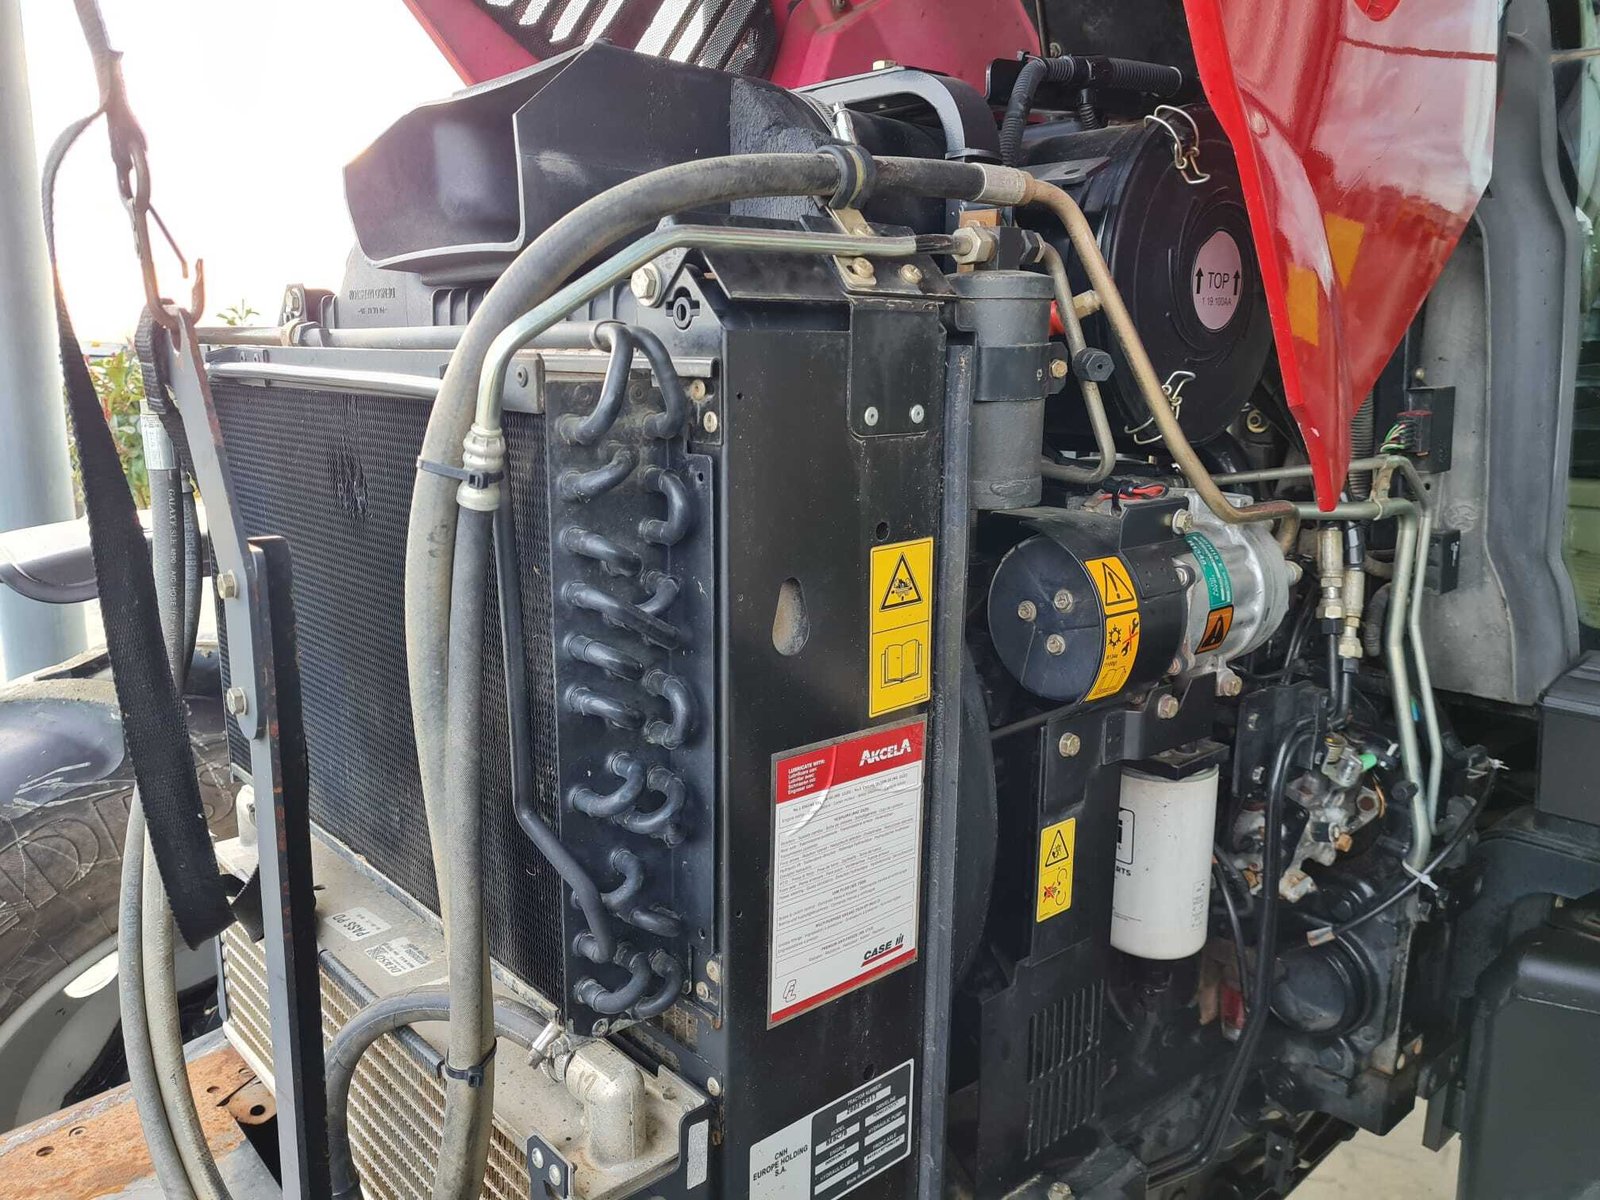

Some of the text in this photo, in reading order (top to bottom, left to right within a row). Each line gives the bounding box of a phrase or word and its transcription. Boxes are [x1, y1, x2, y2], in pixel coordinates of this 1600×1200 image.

[1208, 271, 1230, 289] TOP
[168, 488, 177, 527] GALAXY
[859, 738, 912, 767] AKCELA
[344, 921, 370, 937] PASS
[863, 940, 893, 961] CASE
[752, 1160, 780, 1181] EUROPE
[780, 1144, 809, 1165] HOLDING
[774, 1147, 788, 1160] CNH
